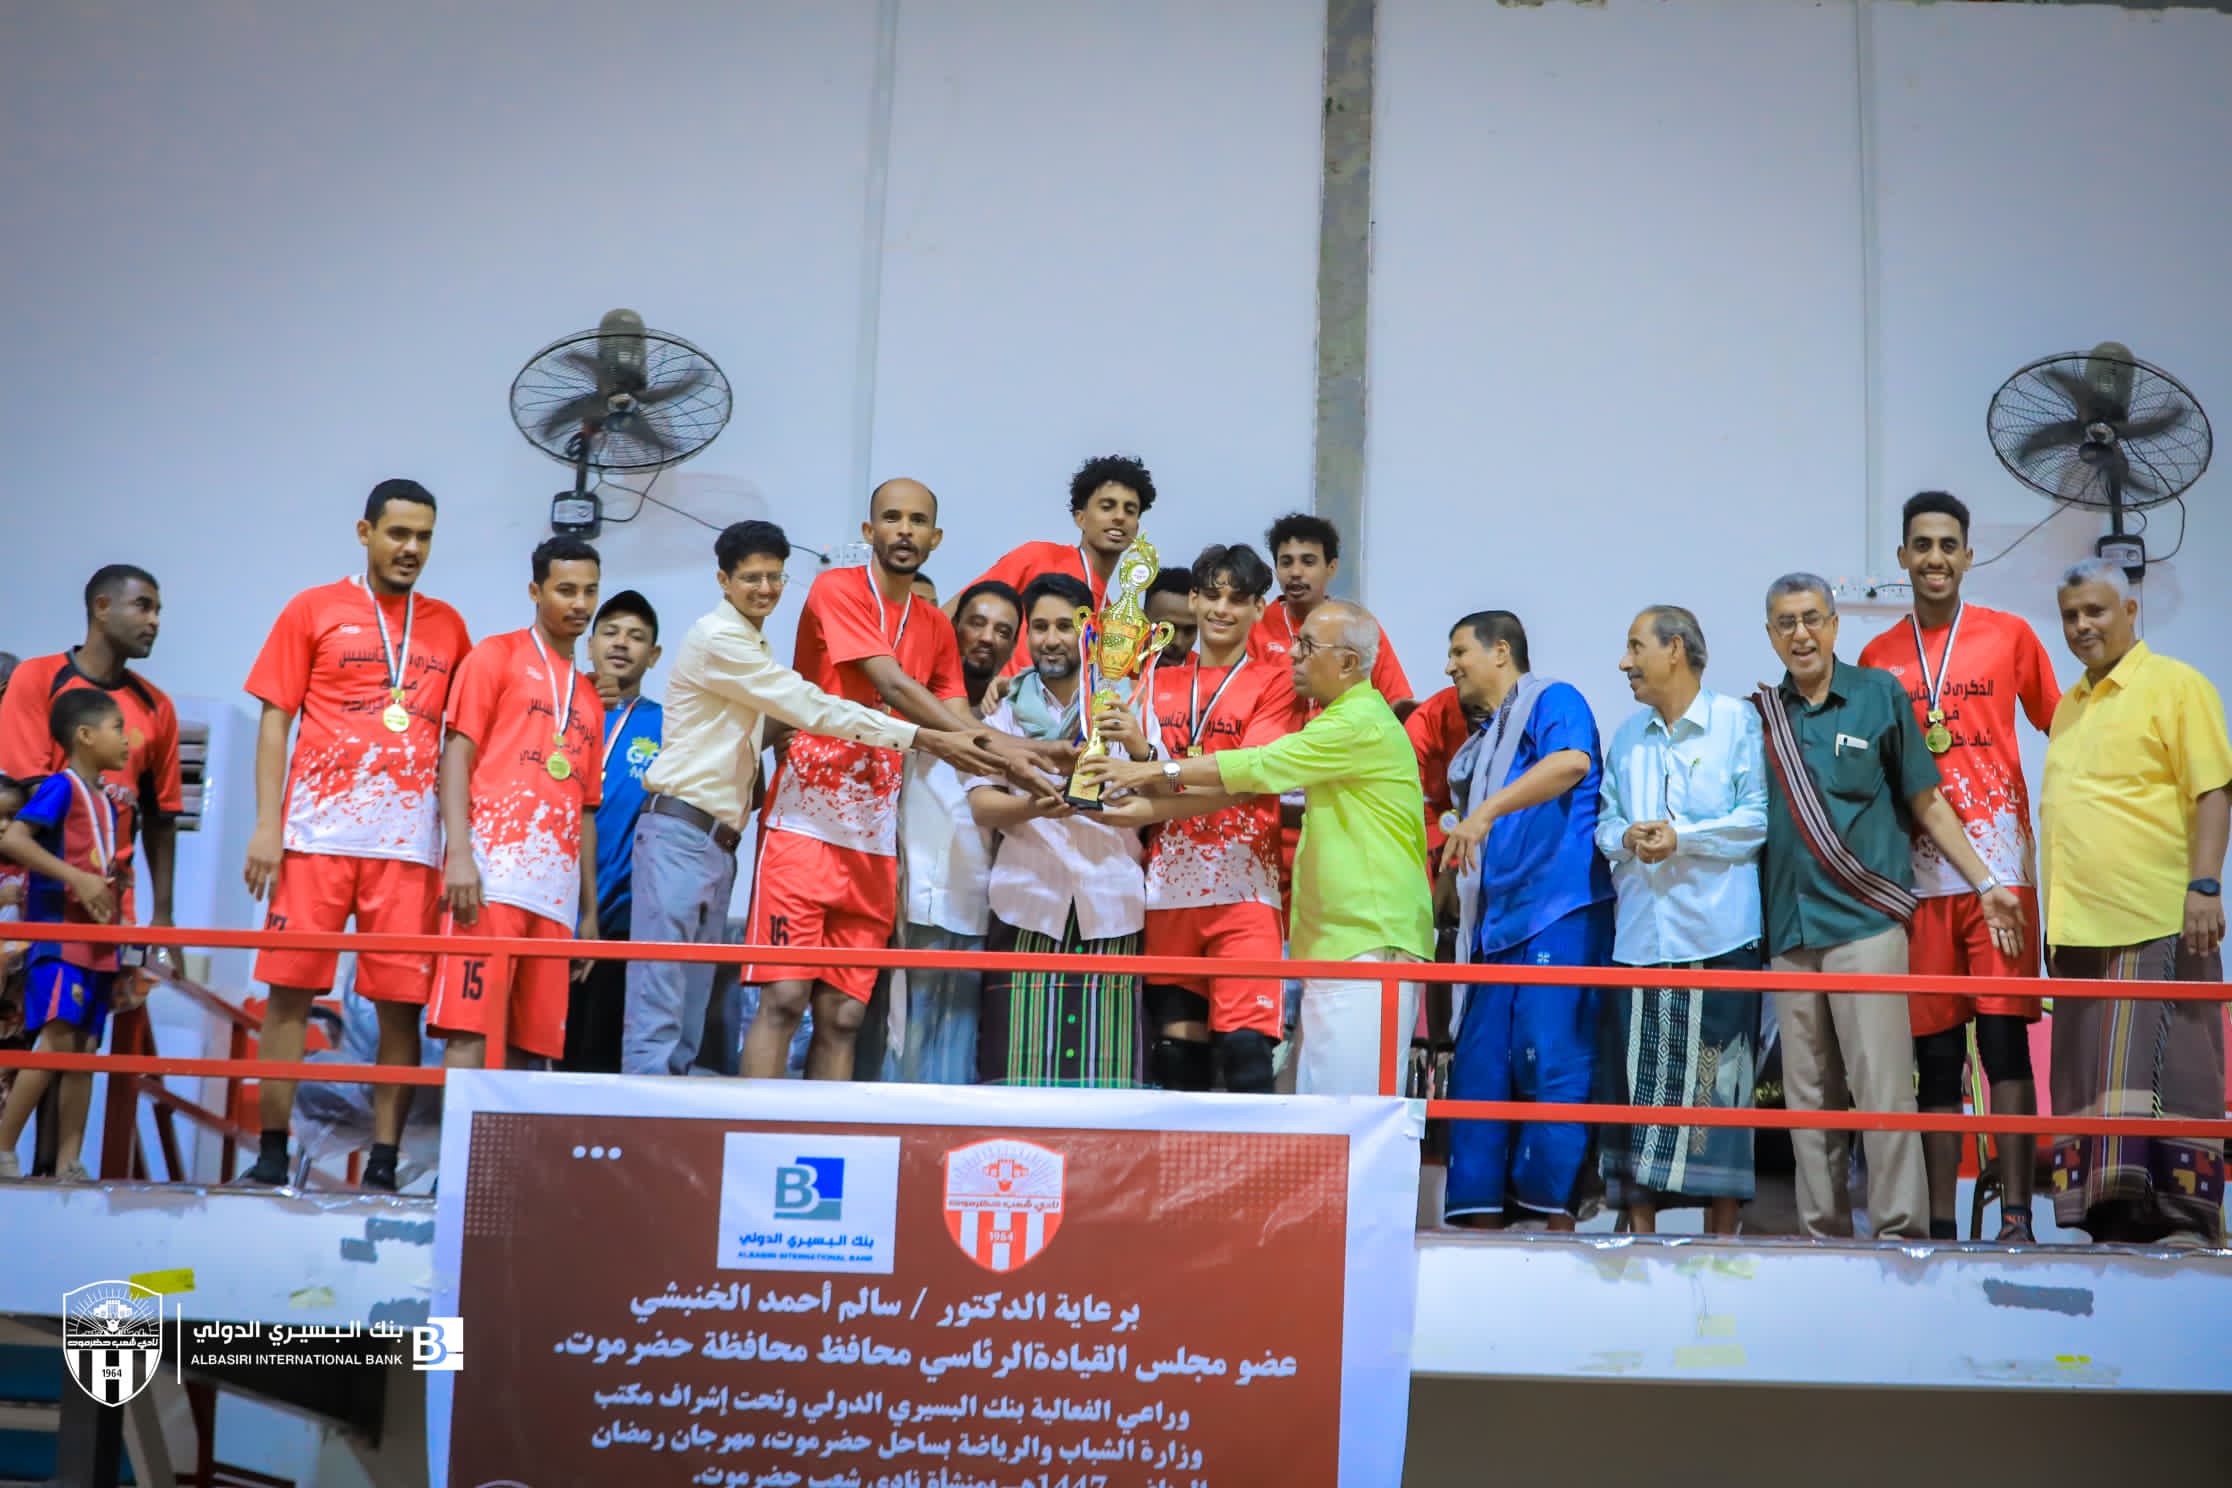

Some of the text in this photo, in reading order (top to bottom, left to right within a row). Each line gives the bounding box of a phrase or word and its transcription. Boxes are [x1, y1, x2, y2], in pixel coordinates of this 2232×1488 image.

[461, 959, 486, 1000] 15
[738, 1232, 875, 1249] بنك البسيري الدولي
[629, 1280, 751, 1324] الخنبشي
[757, 1280, 833, 1313] أحمد
[838, 1286, 902, 1324] سالم
[936, 1291, 1047, 1328] الدكتور
[1054, 1292, 1141, 1333] برعاية
[553, 1331, 694, 1366] حضرموت.
[701, 1329, 809, 1363] محافظة
[816, 1334, 912, 1367] محافظ
[1135, 1346, 1228, 1383] مجلس
[1235, 1349, 1297, 1386] عضو
[594, 1382, 1190, 1435] وراعي الفعالية بنك البسيري الدولي وتحت إشراف مكتب
[591, 1420, 665, 1451] رمضان
[670, 1423, 756, 1454] مهرجان
[877, 1431, 952, 1461] بساحل
[957, 1433, 1053, 1466] والرياضة
[1058, 1438, 1135, 1466] الشباب
[1140, 1439, 1203, 1470] وزارة
